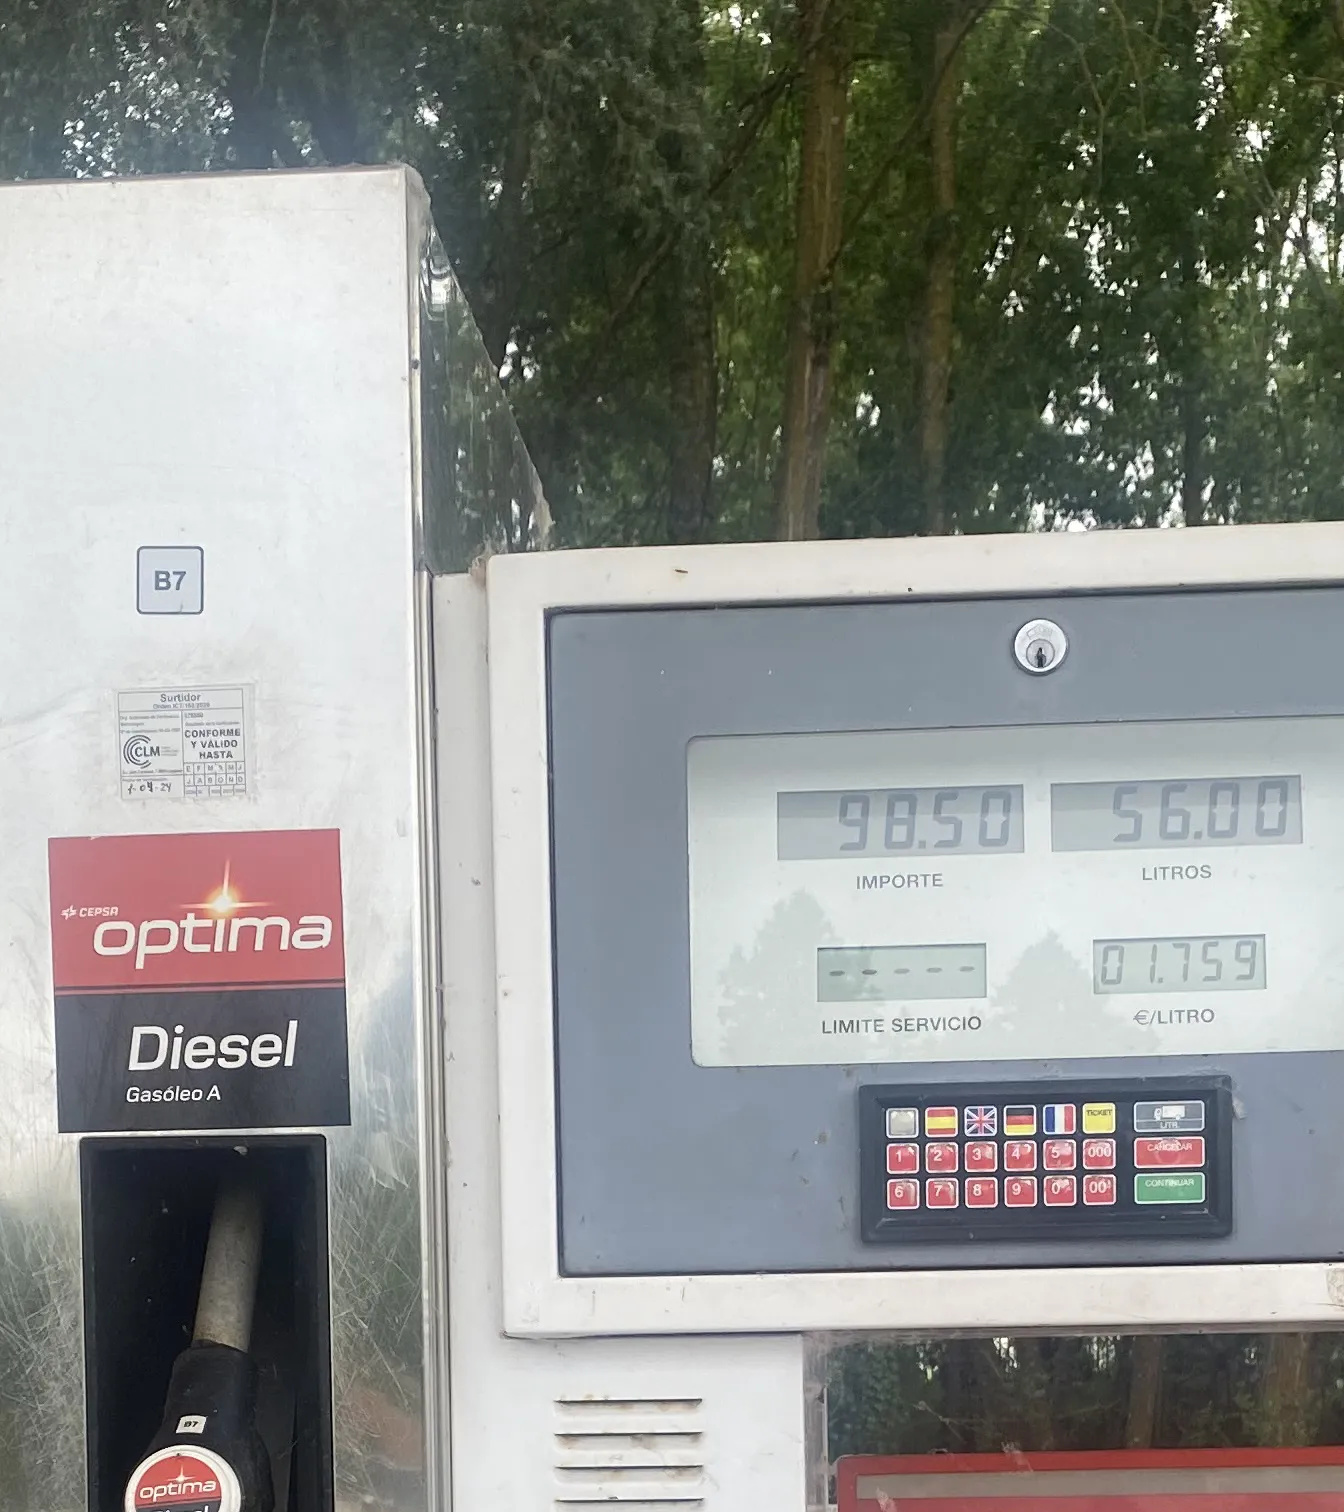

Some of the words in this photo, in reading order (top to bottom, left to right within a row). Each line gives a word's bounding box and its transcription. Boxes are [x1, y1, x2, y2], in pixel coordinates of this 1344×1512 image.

[154, 570, 187, 591] B7
[160, 693, 201, 702] Surtidor
[185, 729, 241, 738] CONFORME
[135, 746, 161, 757] CLM
[199, 751, 233, 760] HASTA
[1113, 780, 1289, 842] 56.00
[838, 790, 1012, 851] 98.50
[1142, 864, 1212, 881] LITROS
[856, 873, 944, 890] IMPORTE
[79, 906, 119, 918] CEPSA
[93, 912, 333, 970] optima
[1100, 940, 1258, 985] 01.759
[1133, 1008, 1215, 1026] €/LITRO
[821, 1018, 885, 1034] LIMITE
[891, 1016, 983, 1033] SERVICIO
[128, 1020, 298, 1071] Diesel
[126, 1085, 203, 1103] Gasóleo
[206, 1085, 221, 1101] A
[933, 1149, 943, 1162] 2
[972, 1148, 982, 1161] 3
[1012, 1147, 1021, 1160] 4
[1051, 1146, 1061, 1159] 5
[1088, 1146, 1112, 1158] 000
[1012, 1182, 1021, 1196] 9
[1051, 1182, 1061, 1195] 0
[1145, 1178, 1195, 1188] CONTINUAR
[894, 1185, 904, 1198] 6
[934, 1184, 943, 1197] 7
[972, 1184, 982, 1197] 8
[139, 1480, 217, 1502] optima
